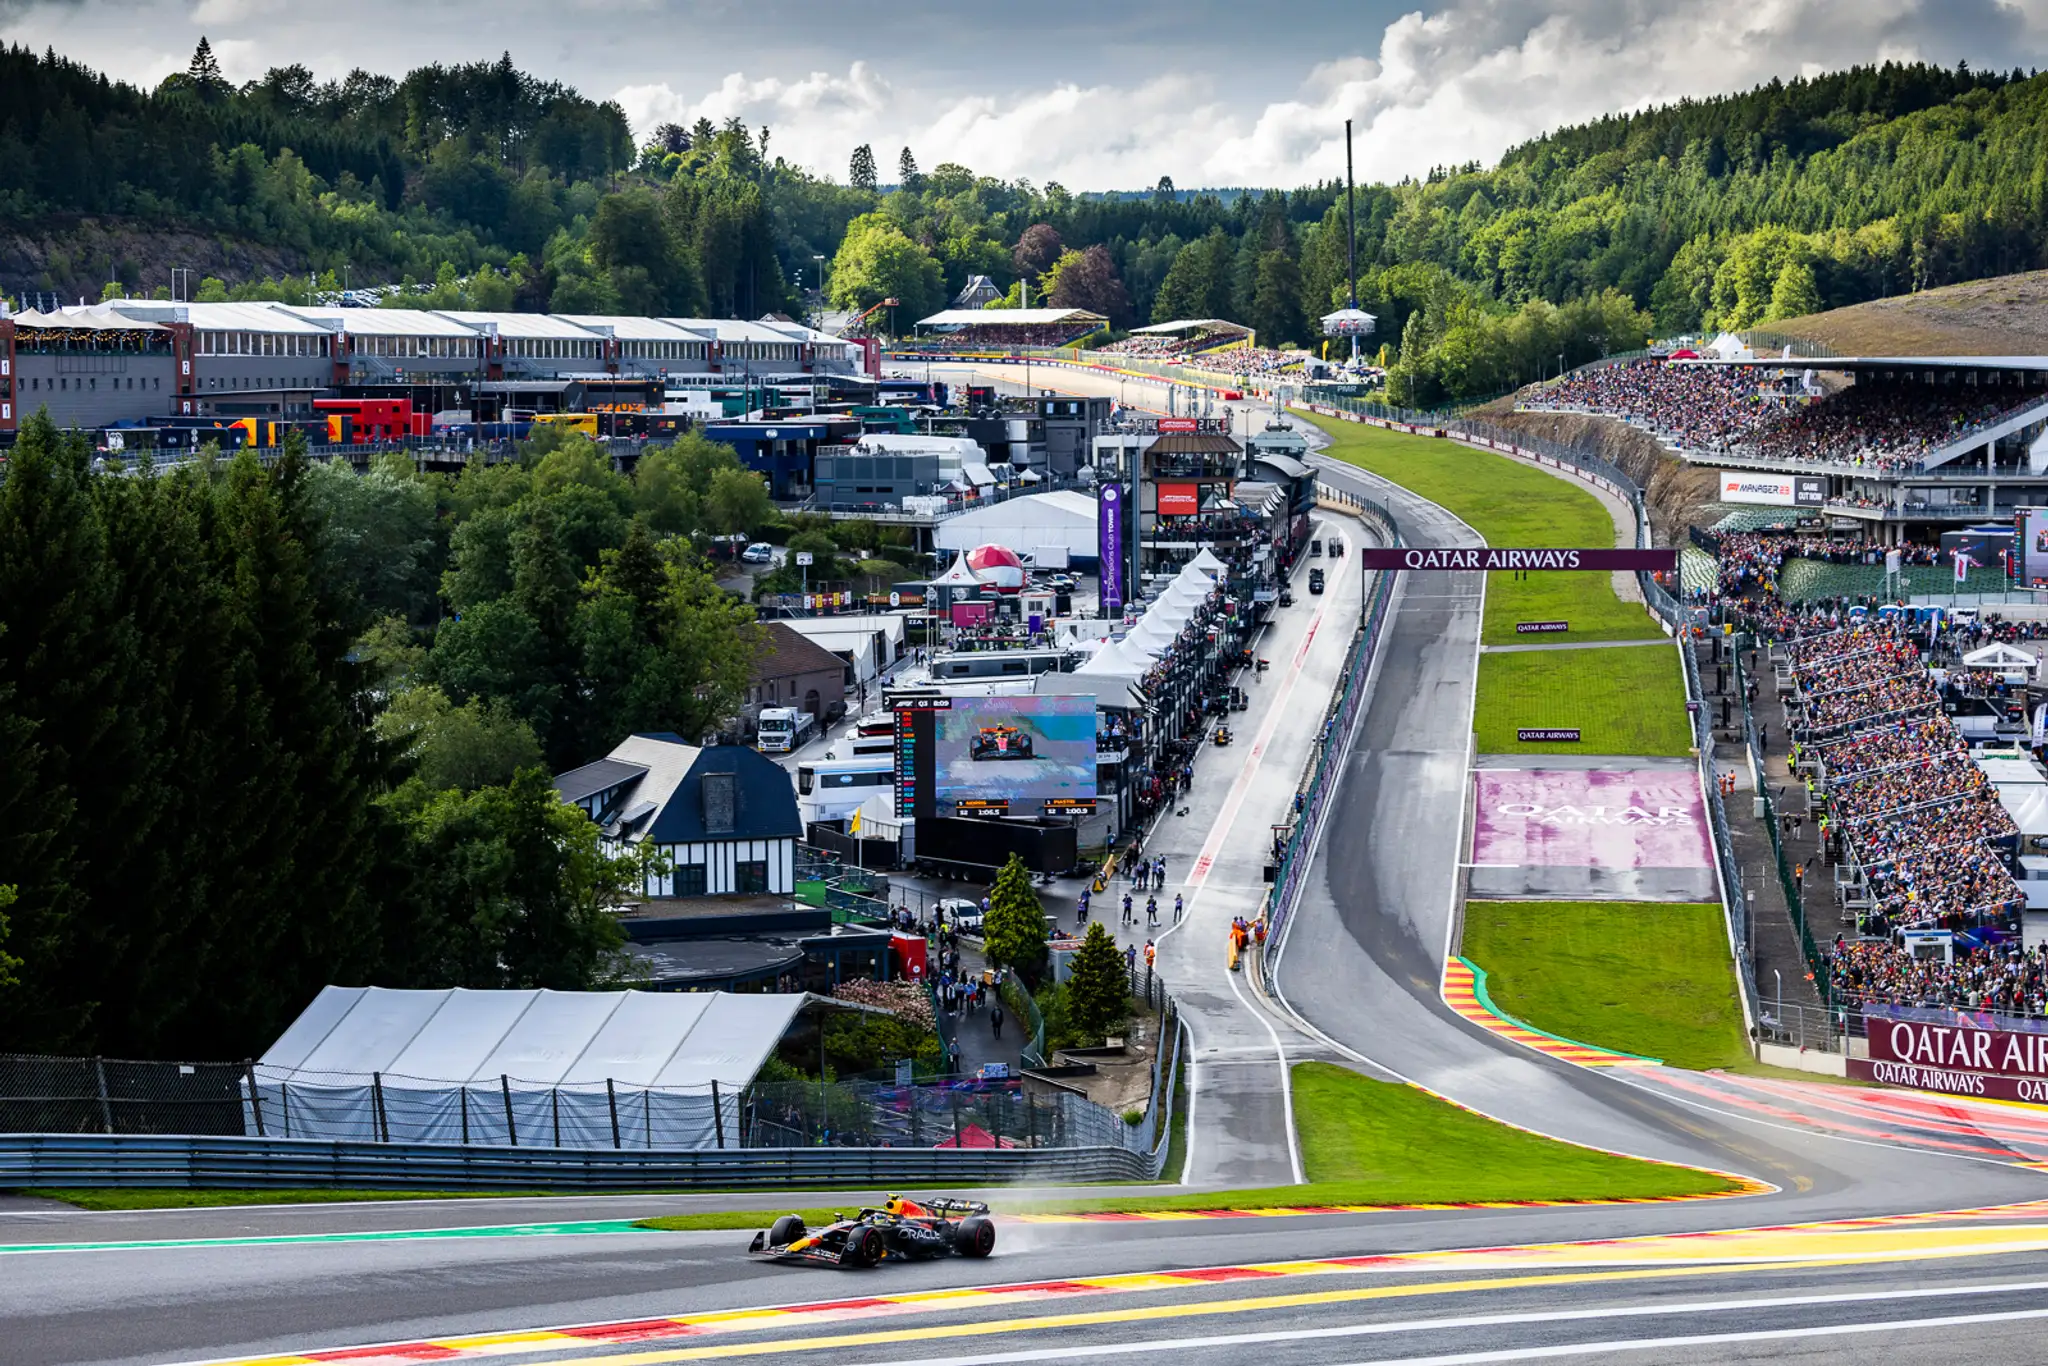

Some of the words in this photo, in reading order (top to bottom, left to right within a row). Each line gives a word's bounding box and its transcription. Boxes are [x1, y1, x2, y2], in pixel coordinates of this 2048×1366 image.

[1740, 483, 1779, 493] MANAGER
[1779, 486, 1790, 495] 23
[1802, 482, 1819, 491] GAME
[1798, 492, 1809, 500] OUT
[1405, 550, 1480, 569] QATAR
[1485, 550, 1580, 568] AIRWAYS
[1517, 624, 1540, 632] QATAR
[1540, 623, 1567, 631] AIRWAYS
[1519, 732, 1545, 740] QATAR
[1497, 803, 1692, 818] QATAR
[1540, 815, 1694, 826] AIRWAYS
[1891, 1023, 1994, 1069] QATAR
[1873, 1061, 1918, 1086] QATAR
[1921, 1069, 1985, 1095] AIRWAYS
[898, 1228, 941, 1240] ORACLE
